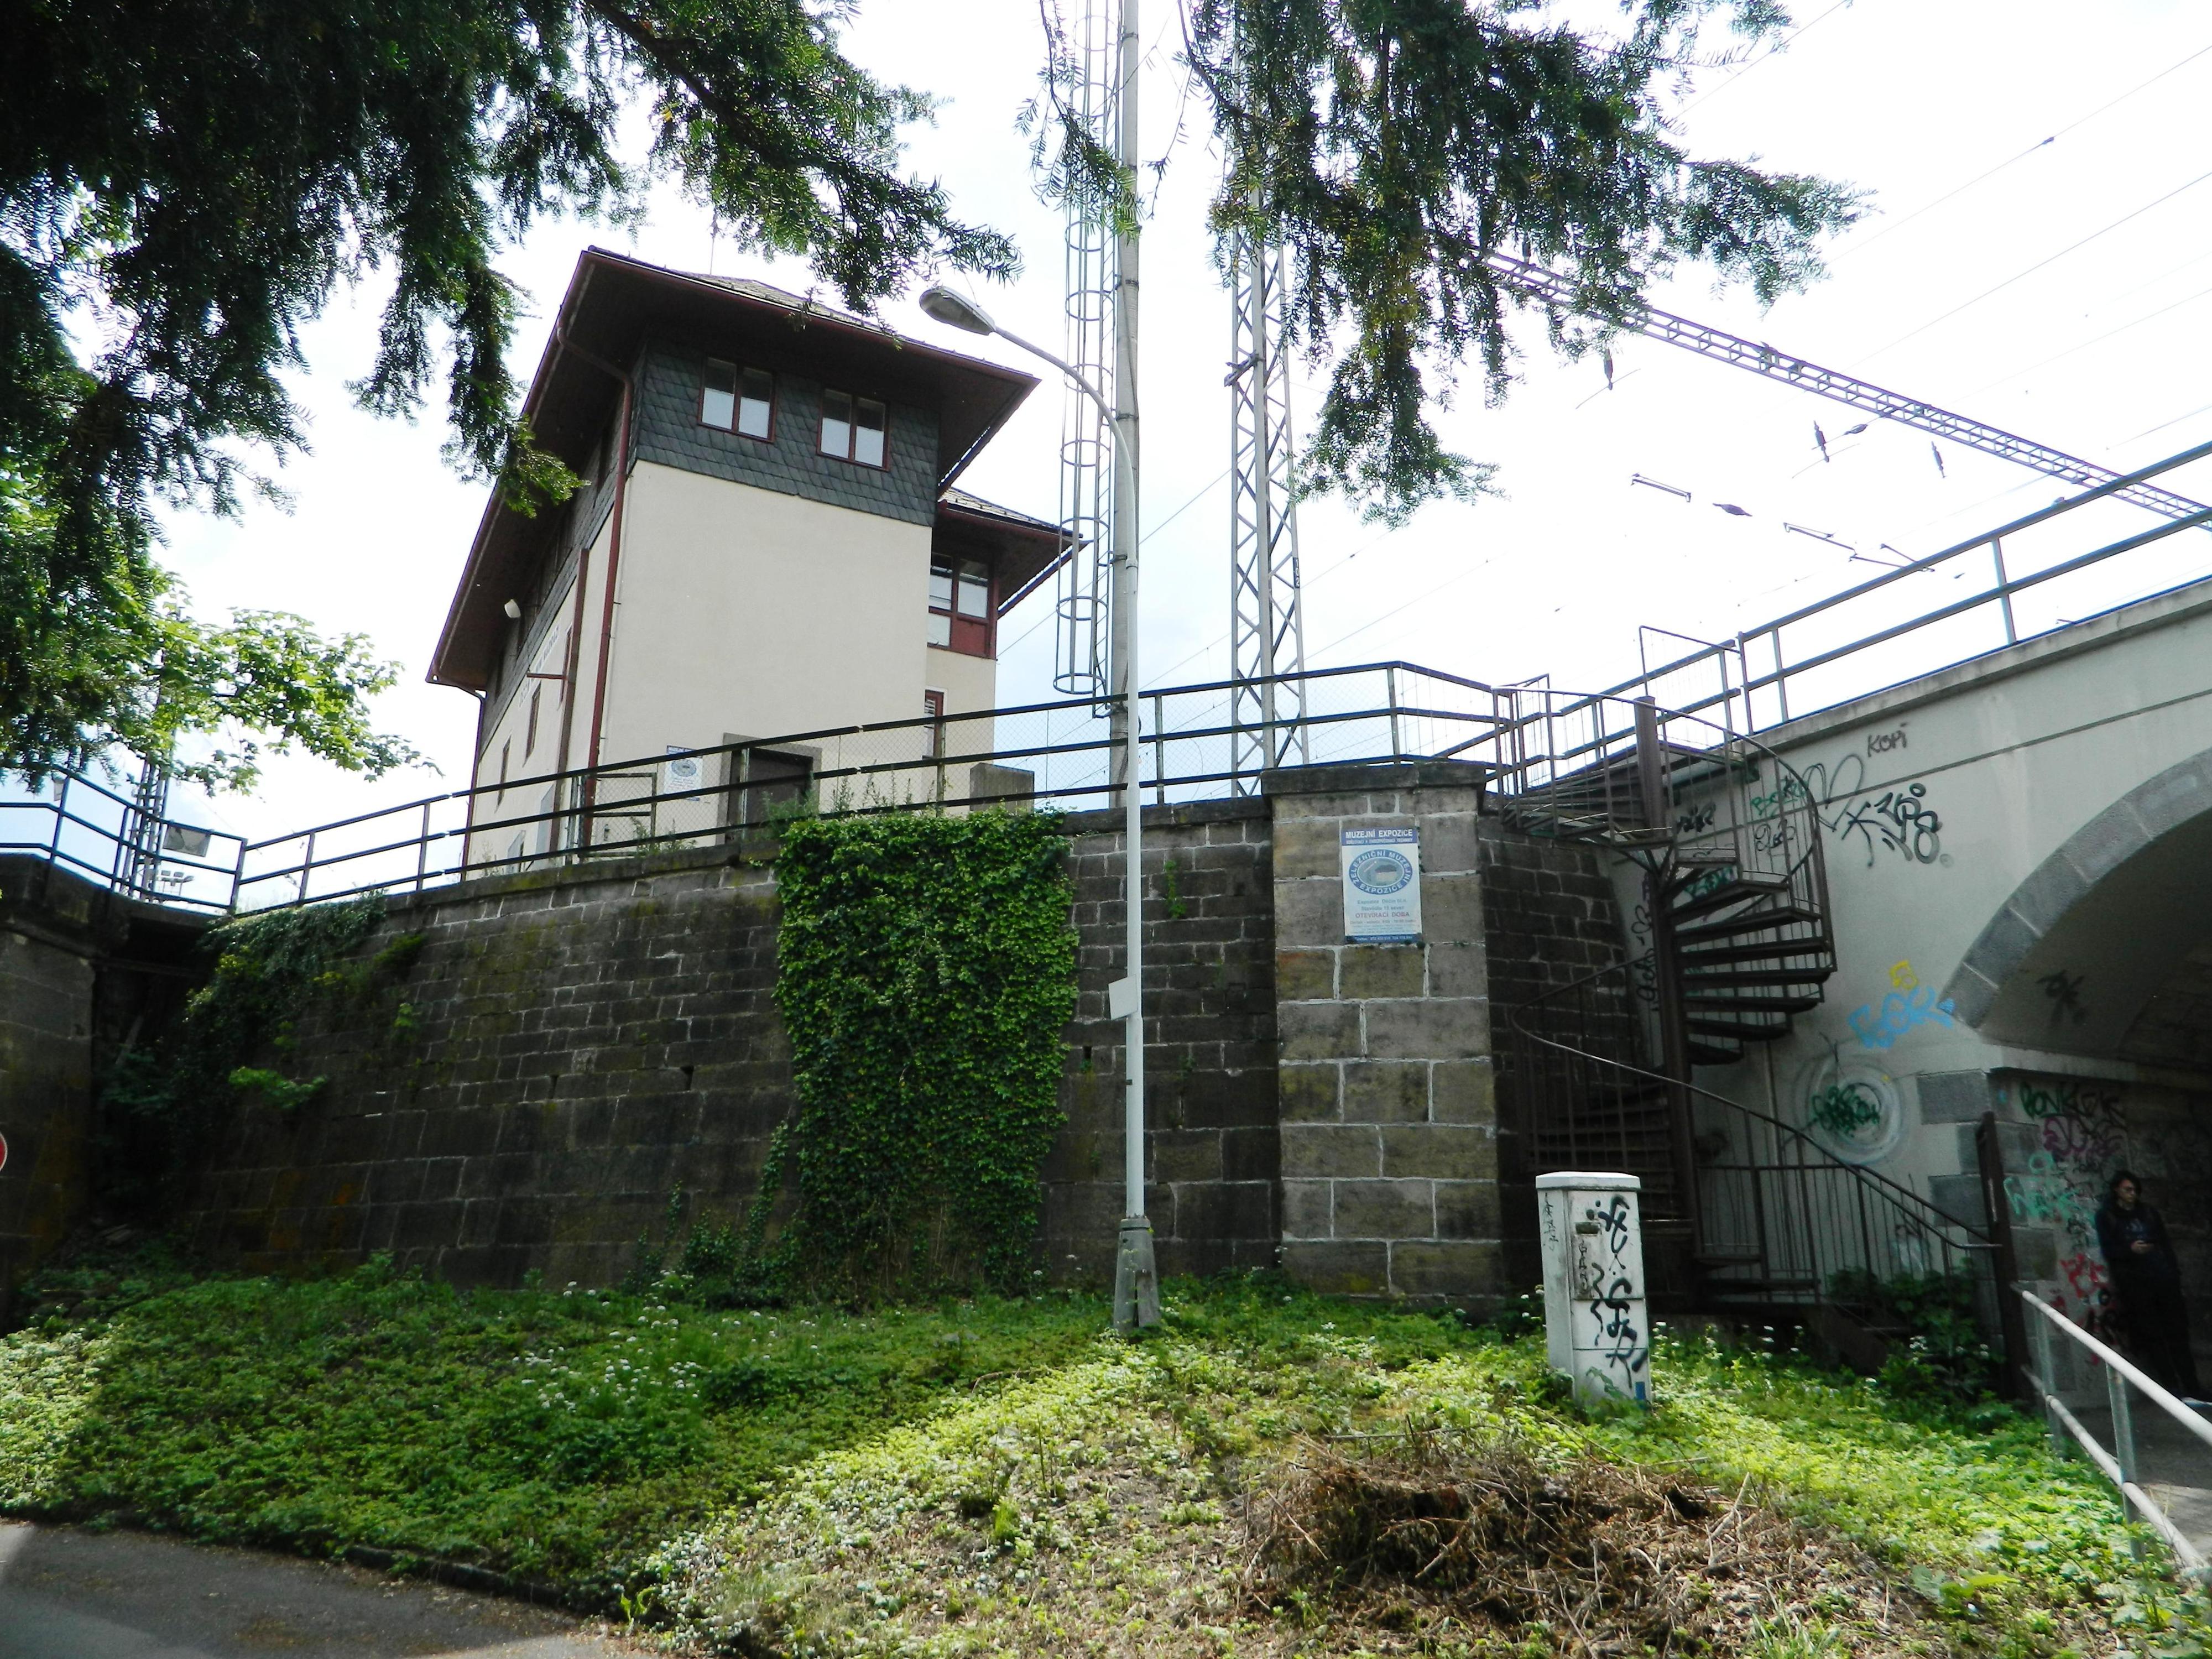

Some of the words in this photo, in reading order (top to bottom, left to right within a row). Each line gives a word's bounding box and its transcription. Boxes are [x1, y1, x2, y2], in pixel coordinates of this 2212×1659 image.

[1345, 829, 1375, 838] MUZEJNÍ
[1379, 829, 1413, 837] EXPOZICE
[1359, 884, 1403, 894] EXPOZICE
